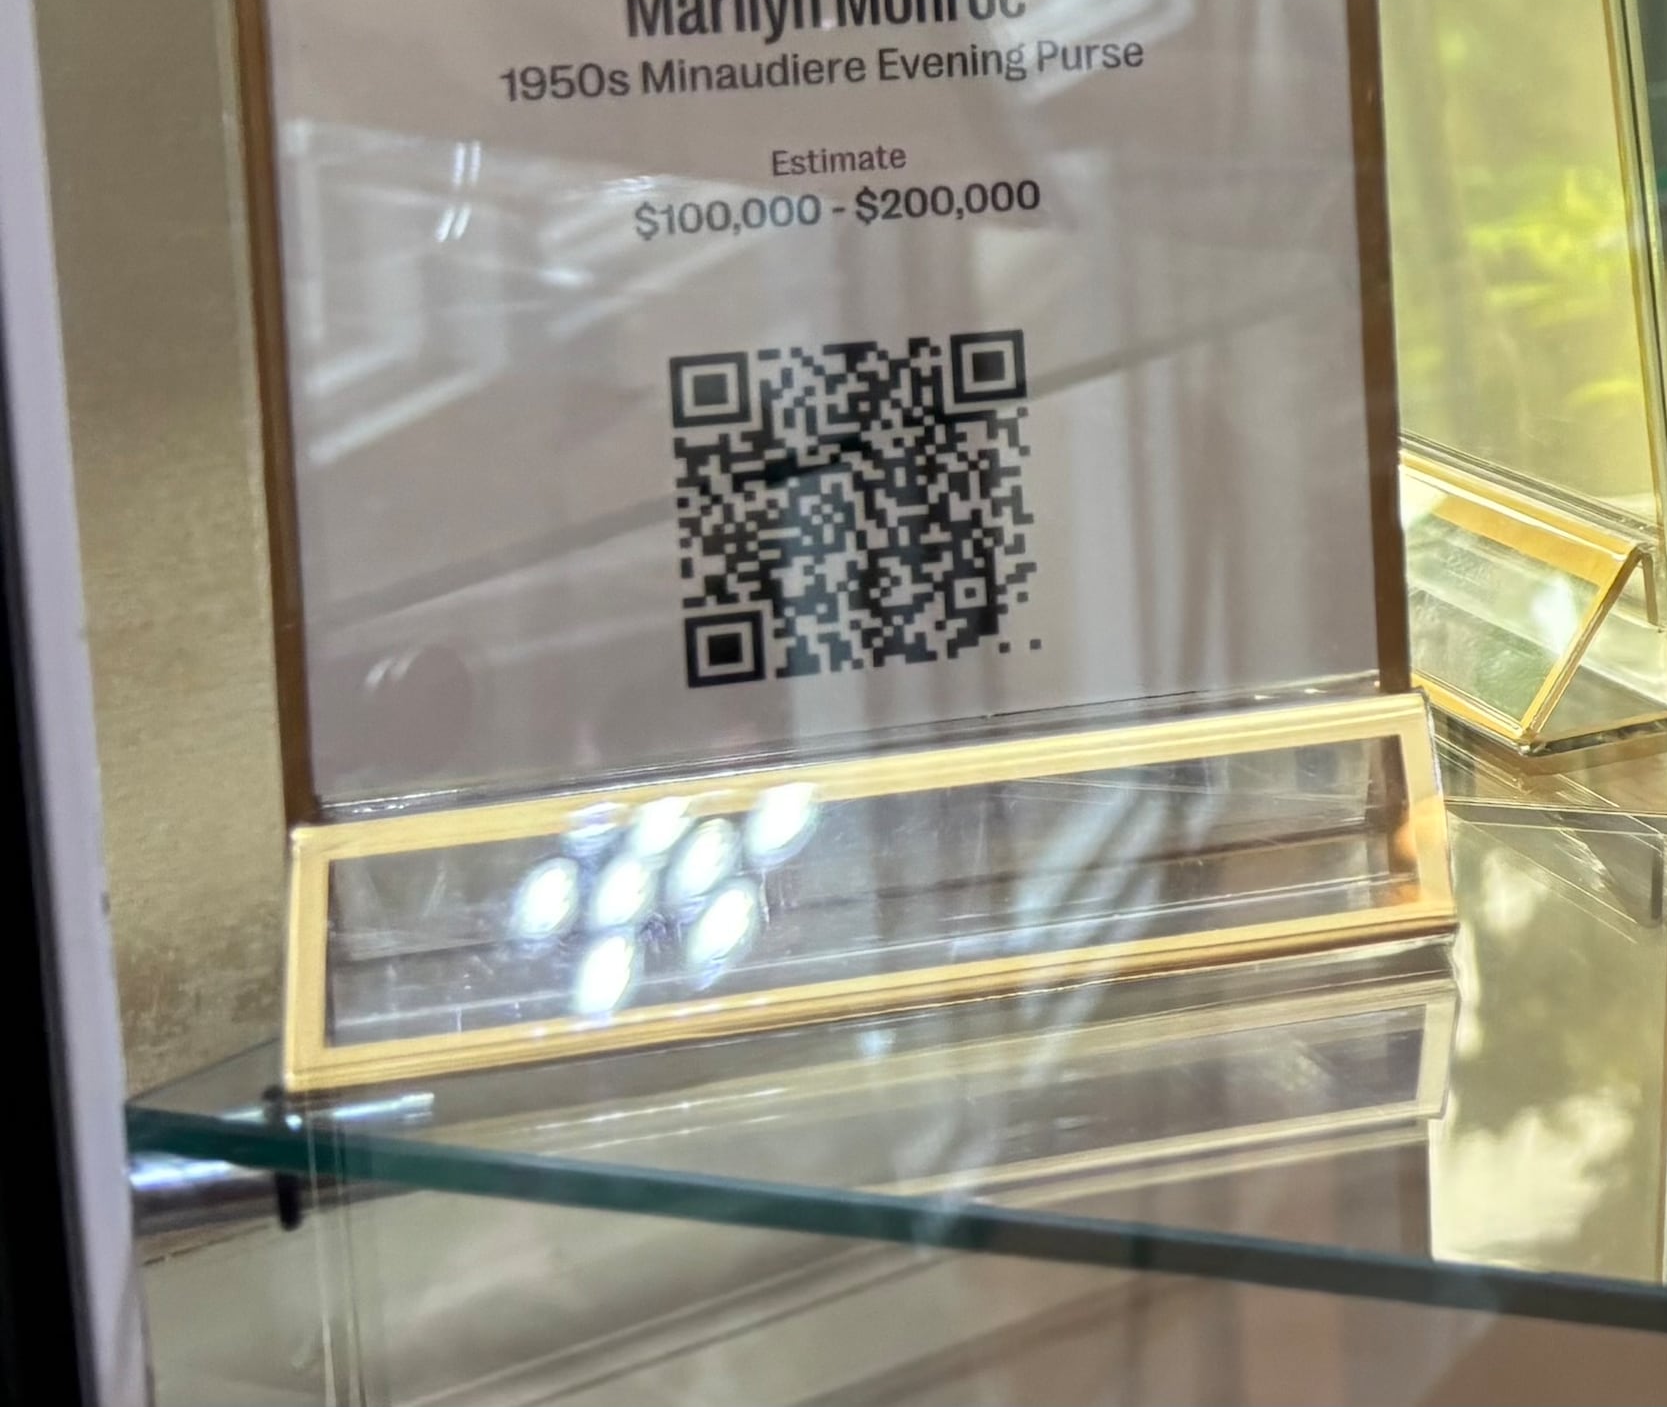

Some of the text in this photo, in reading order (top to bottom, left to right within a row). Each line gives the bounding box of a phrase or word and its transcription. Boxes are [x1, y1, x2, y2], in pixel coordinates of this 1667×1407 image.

[500, 37, 1145, 102] 1950s Minaudiere Evening Purse
[772, 144, 908, 177] Estimate
[634, 193, 822, 242] $100,000
[855, 179, 1041, 226] $200,000
